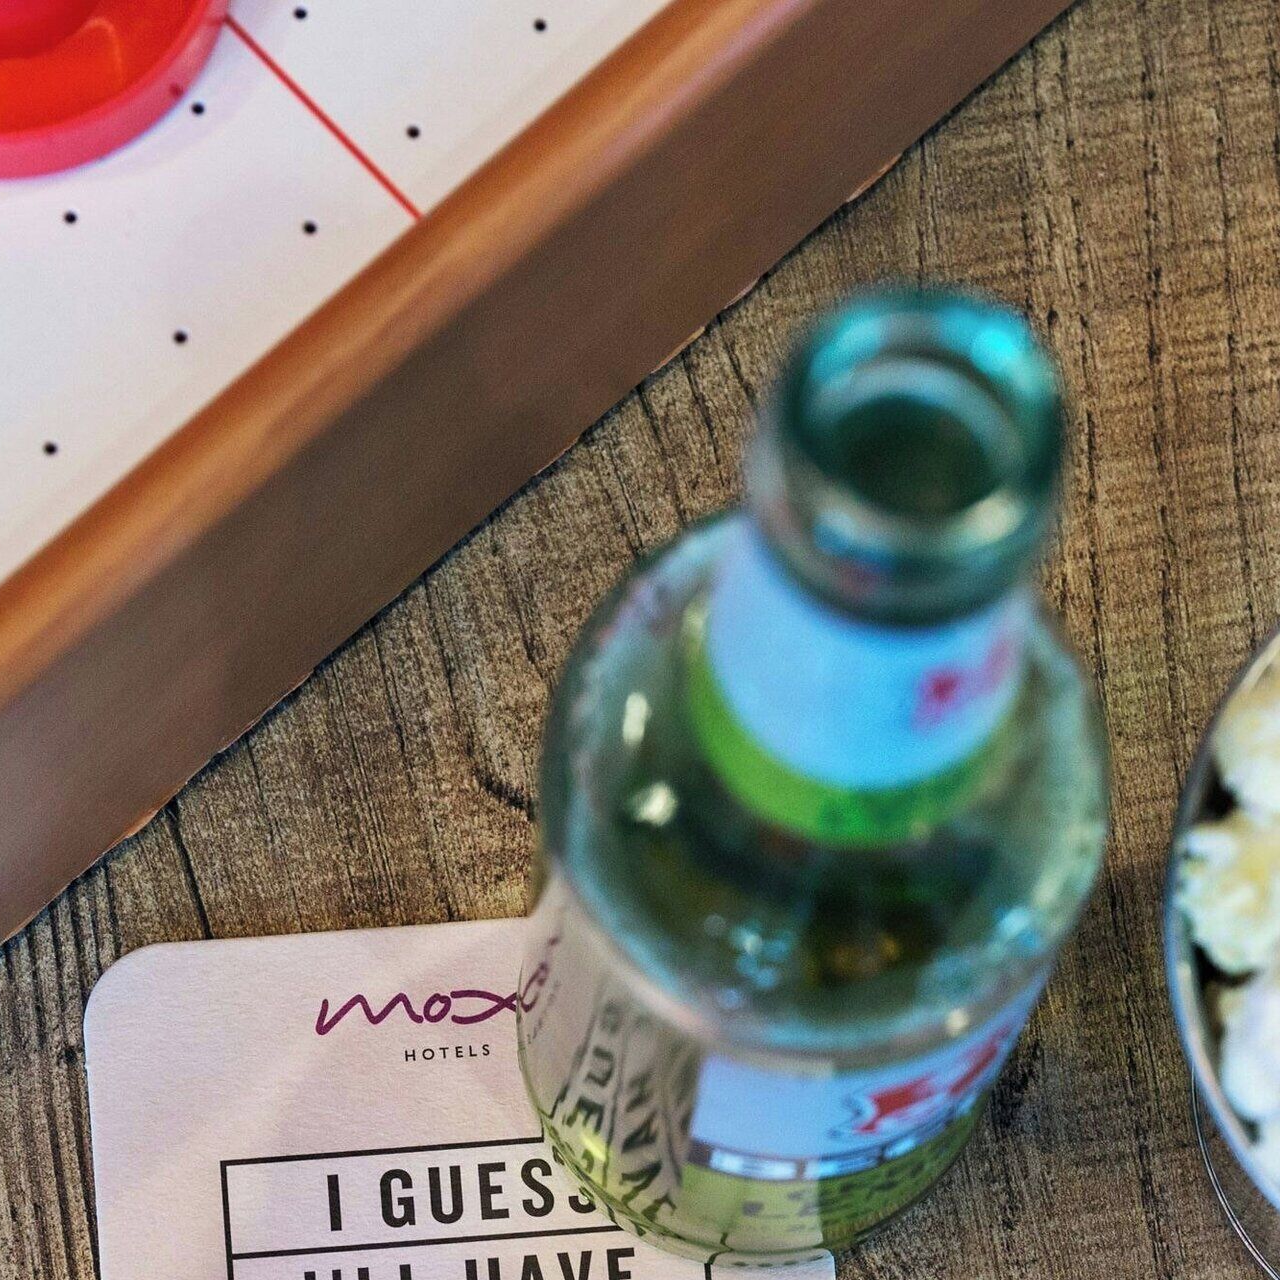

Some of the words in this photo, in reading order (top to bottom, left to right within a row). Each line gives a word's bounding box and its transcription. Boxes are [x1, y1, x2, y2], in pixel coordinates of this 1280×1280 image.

[315, 990, 519, 1036] mox
[404, 1043, 491, 1062] HOTELS
[326, 1174, 343, 1232] I
